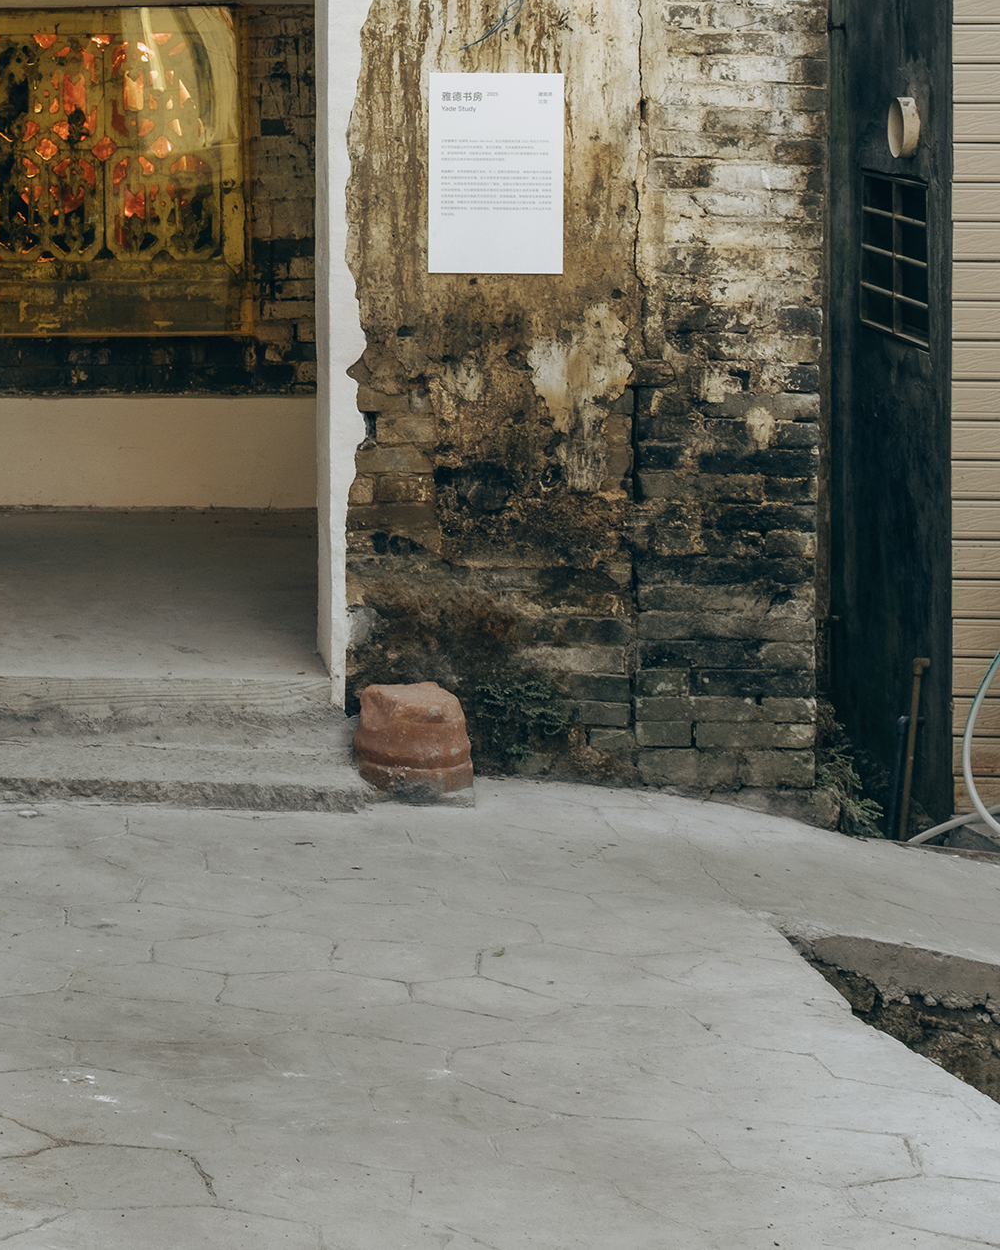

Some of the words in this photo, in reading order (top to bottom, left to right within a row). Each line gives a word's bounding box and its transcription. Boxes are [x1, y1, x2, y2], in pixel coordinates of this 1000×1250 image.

[441, 91, 483, 102] 雅德书房
[458, 105, 477, 113] Study
